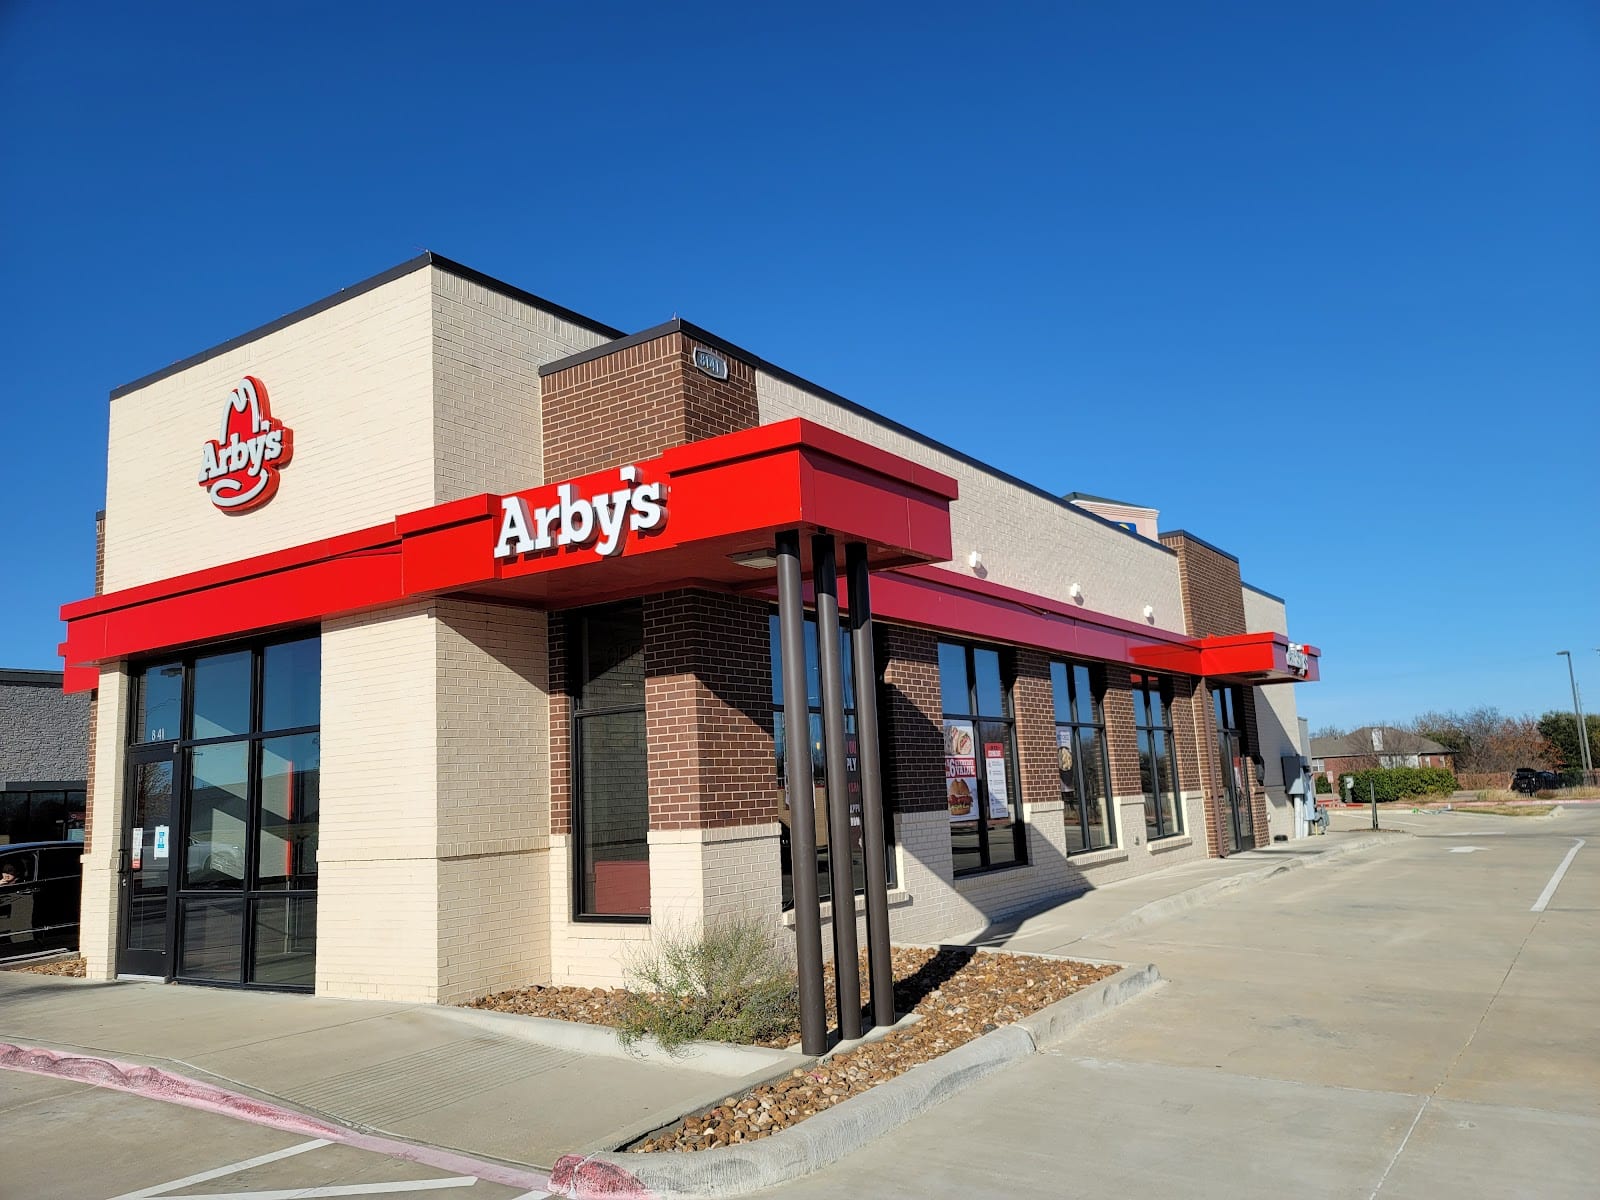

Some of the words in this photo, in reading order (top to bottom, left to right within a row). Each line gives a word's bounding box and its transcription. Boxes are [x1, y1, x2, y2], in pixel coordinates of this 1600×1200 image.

[198, 419, 283, 483] Arby's
[493, 465, 662, 559] Arby's
[846, 757, 857, 772] PLY
[955, 765, 976, 776] VALUE
